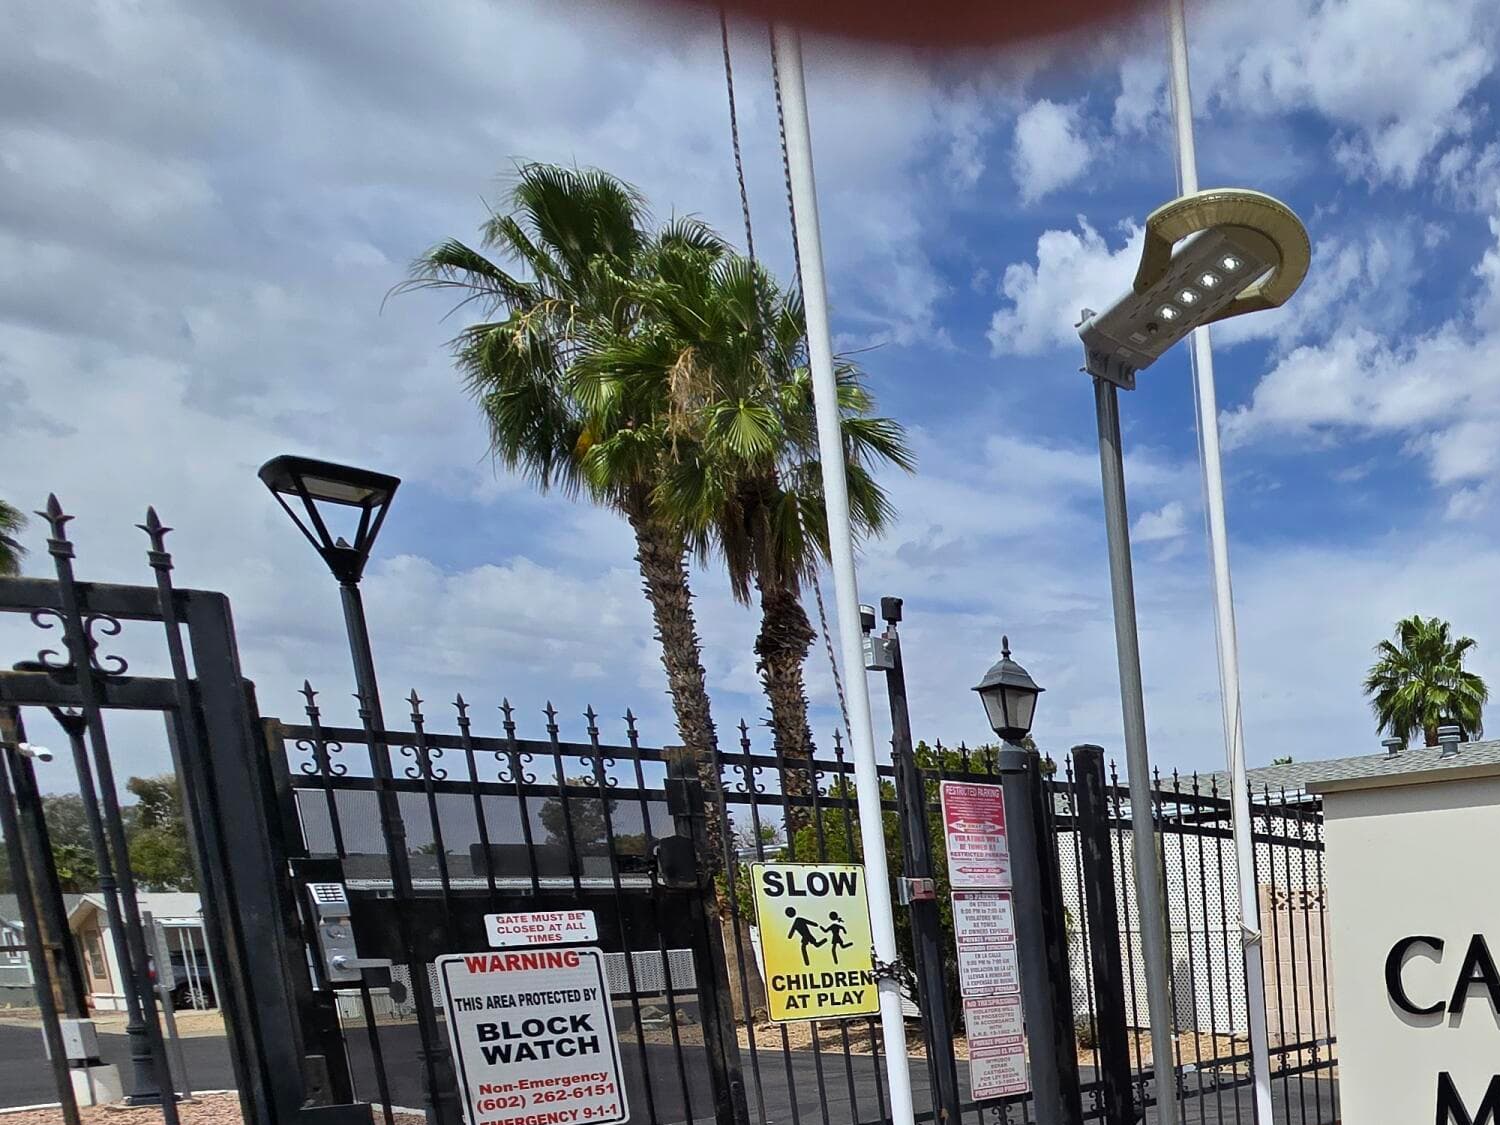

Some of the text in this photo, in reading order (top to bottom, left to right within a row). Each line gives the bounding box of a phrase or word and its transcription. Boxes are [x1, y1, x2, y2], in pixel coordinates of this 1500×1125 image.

[763, 871, 857, 897] SLOW
[496, 913, 584, 924] GATE MUST BE
[497, 922, 587, 934] CLOSED AT ALL
[526, 933, 563, 943] TIMES
[464, 950, 580, 974] WARNING
[772, 970, 877, 991] CHILDREN
[455, 987, 597, 1012] THIS AREA PROTECTED BY
[785, 990, 865, 1010] AT PLAY
[476, 1013, 594, 1042] BLOCK
[480, 1035, 600, 1066] WATCH
[479, 1071, 609, 1095] Non-Emergency
[476, 1083, 615, 1114] (602) 262-6151
[583, 1103, 618, 1119] 9-1-1
